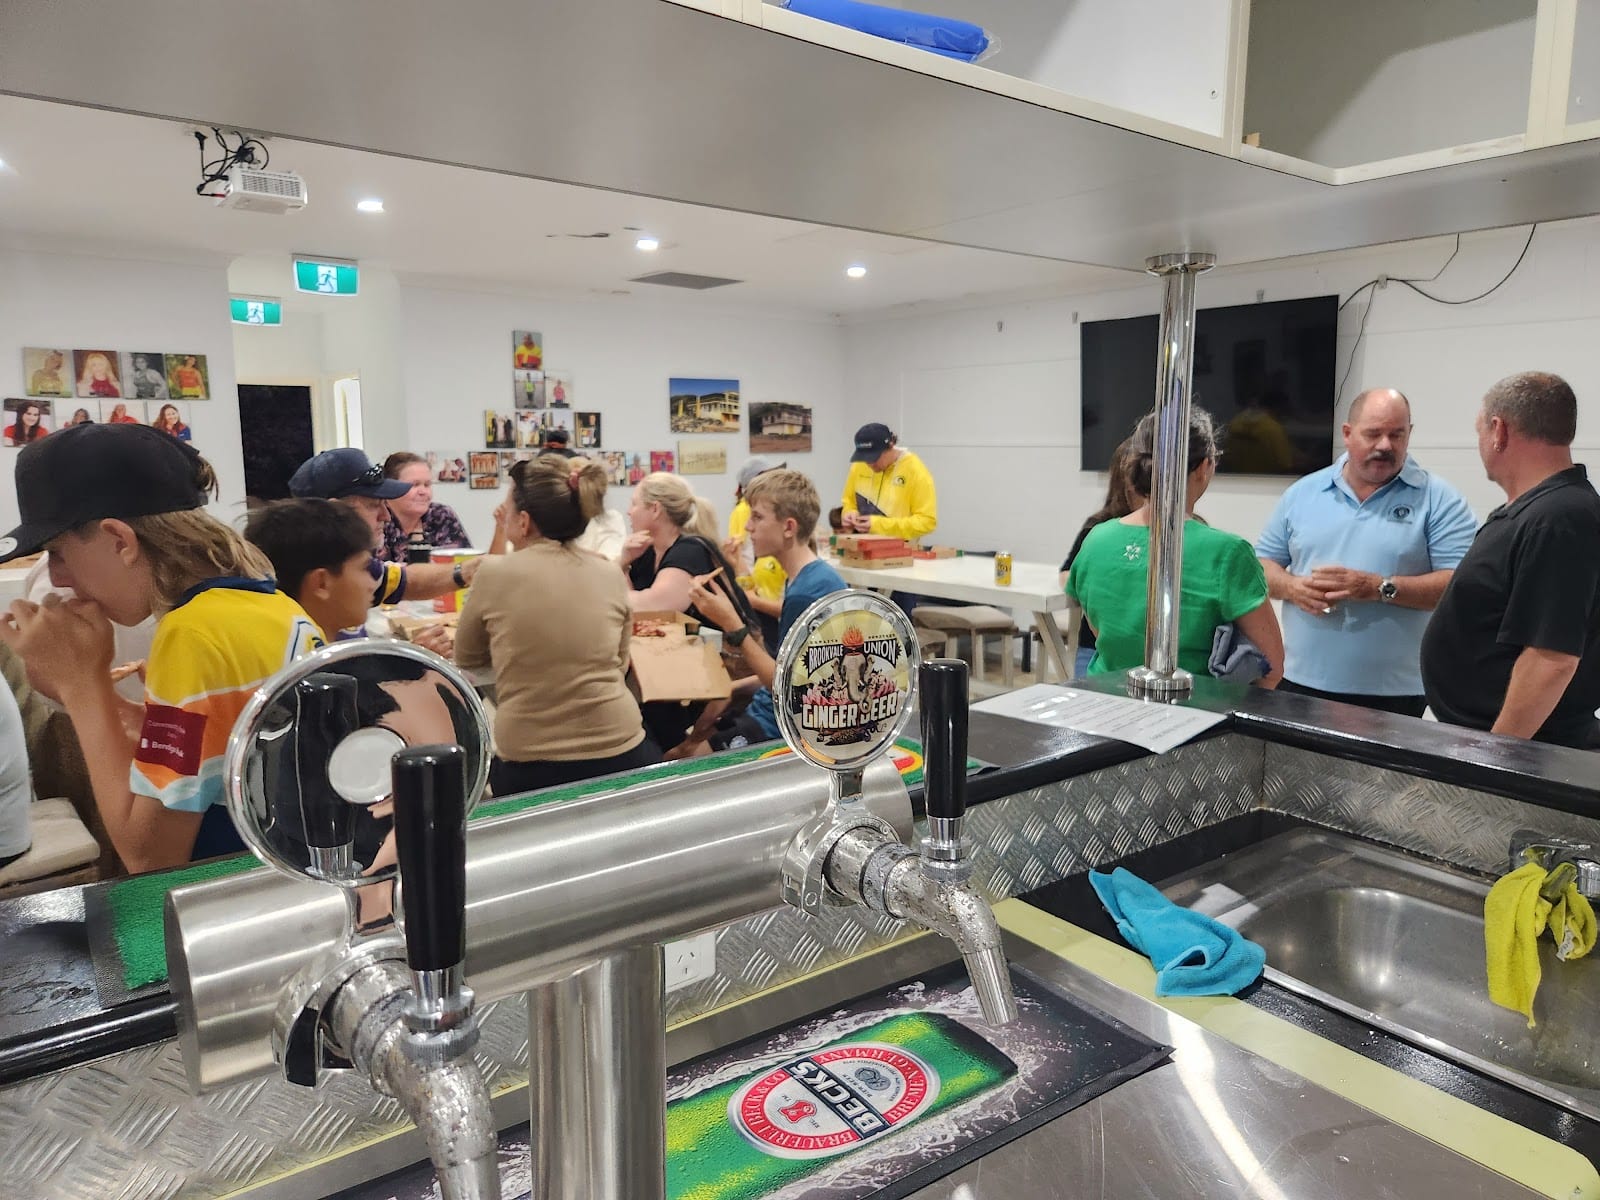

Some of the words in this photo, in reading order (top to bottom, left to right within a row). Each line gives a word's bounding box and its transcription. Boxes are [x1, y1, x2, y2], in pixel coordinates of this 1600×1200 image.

[809, 645, 843, 674] BROOKVALE
[863, 640, 897, 665] UNION
[803, 703, 858, 729] GINGER
[819, 1048, 908, 1067] GERMANY
[767, 1072, 786, 1086] CO
[745, 1092, 764, 1125] BECK
[790, 1061, 883, 1133] BECK'S
[887, 1070, 924, 1120] BREMEN
[758, 1125, 854, 1148] BRAUEREI
